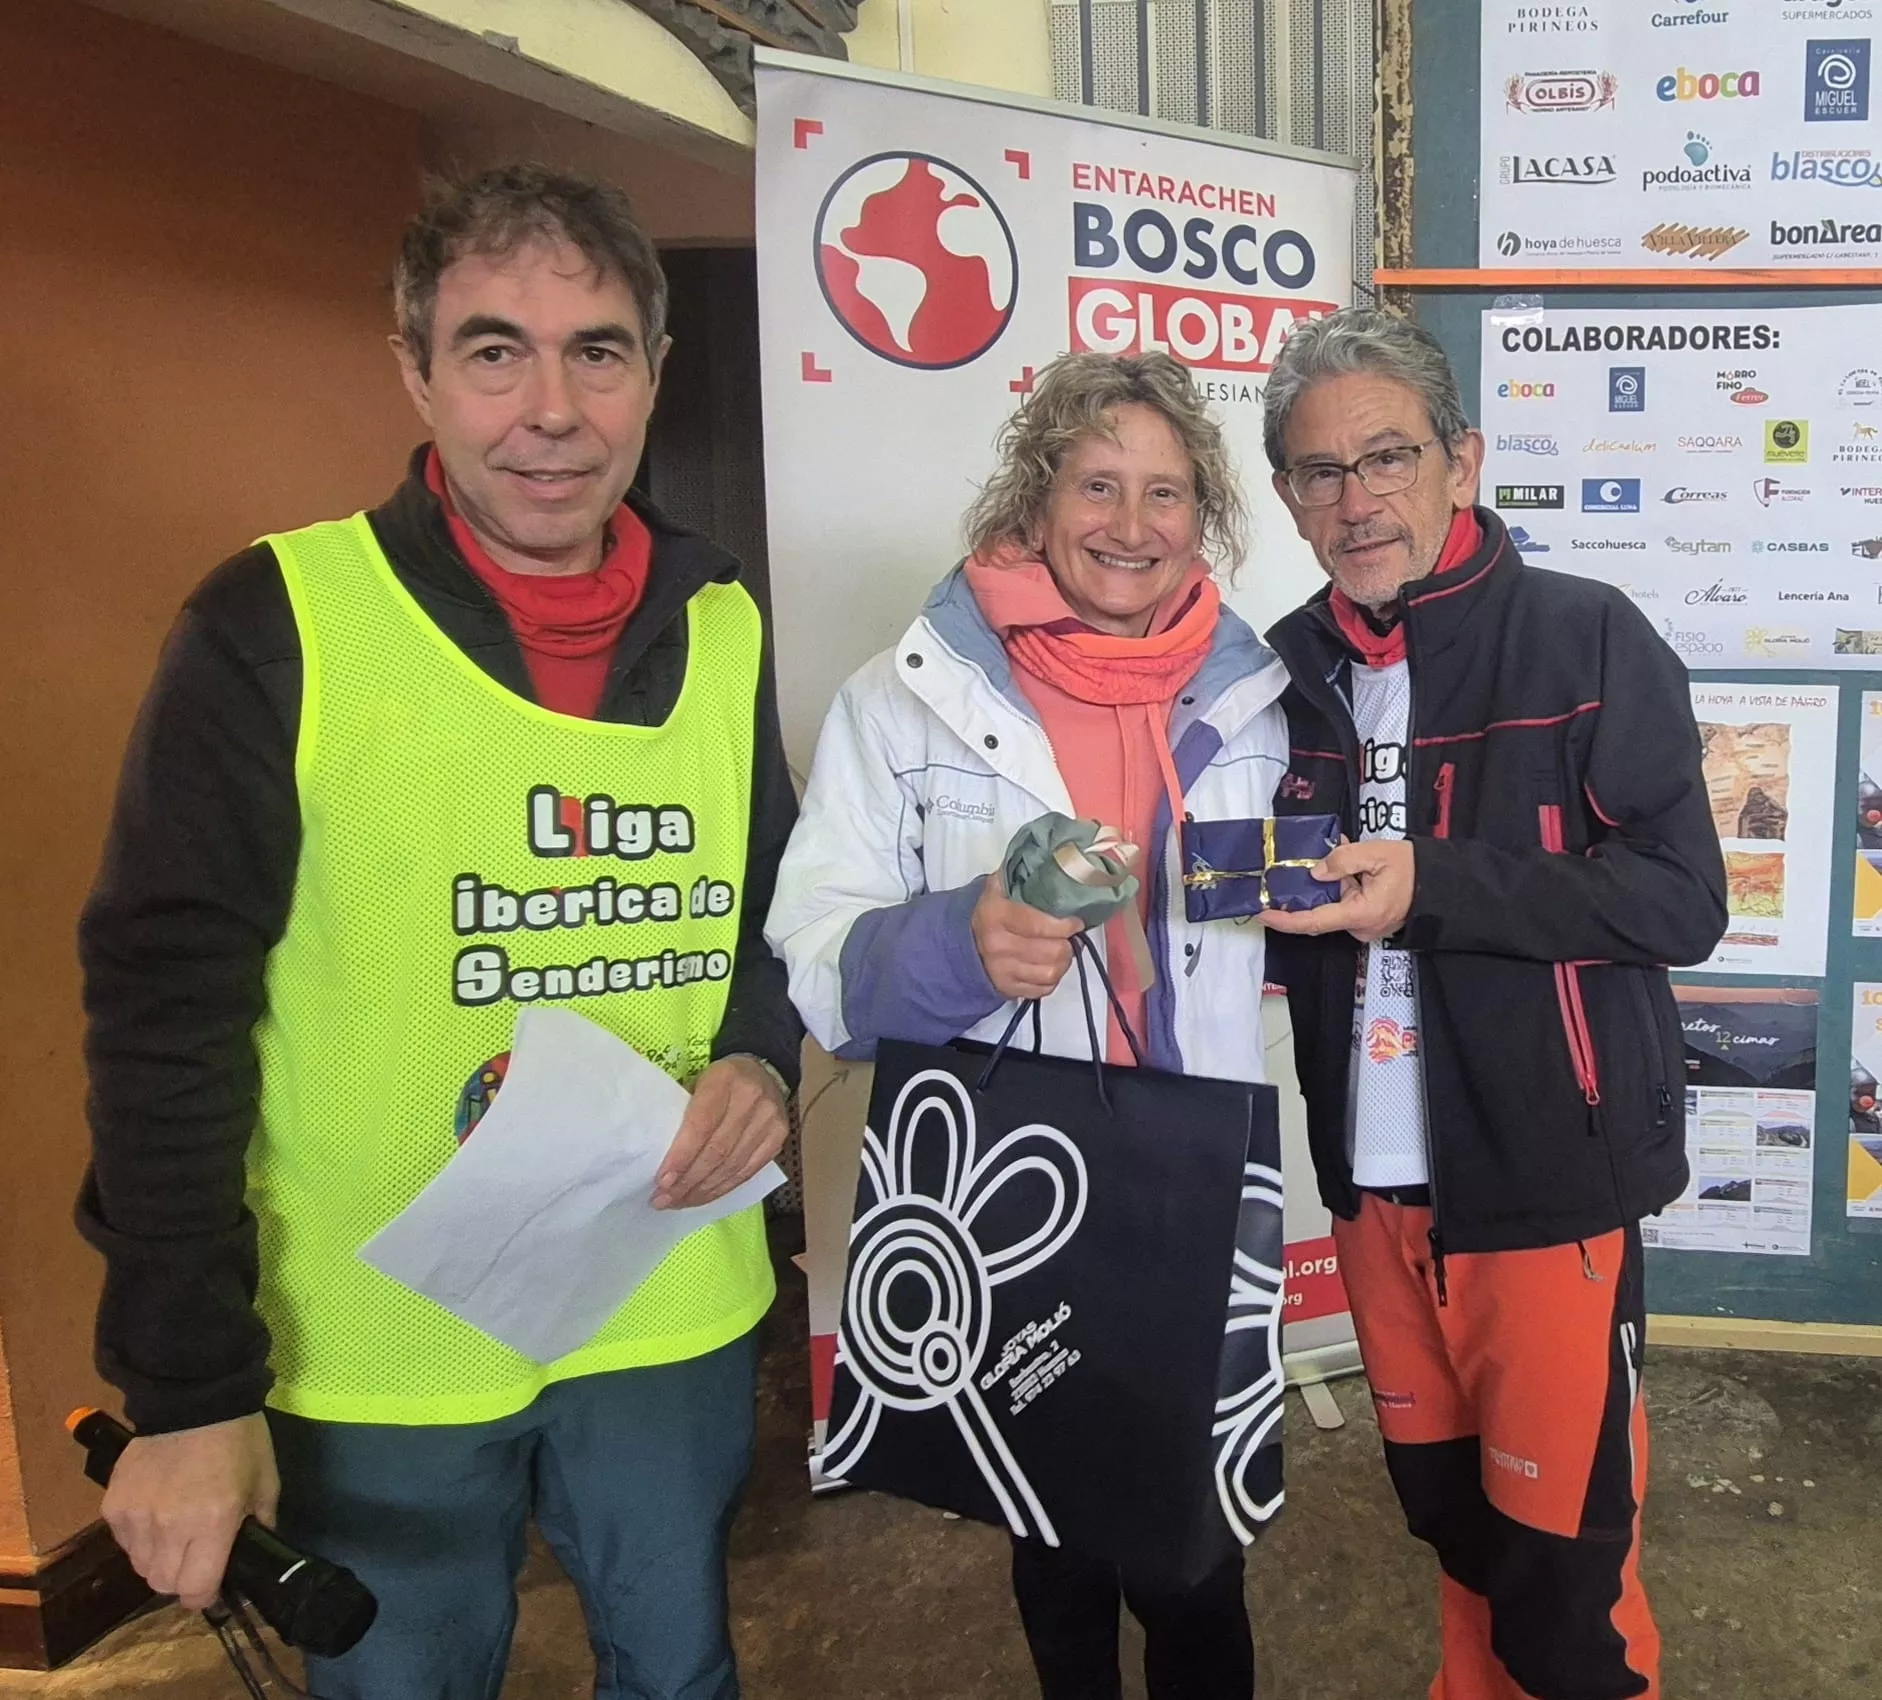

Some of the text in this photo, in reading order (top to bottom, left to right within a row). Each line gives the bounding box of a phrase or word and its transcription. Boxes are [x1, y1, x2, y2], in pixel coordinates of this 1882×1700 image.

[1517, 6, 1588, 18] BODEGA
[1651, 9, 1729, 28] Carrefour
[1782, 10, 1872, 20] SUPERMERCADOS
[1508, 20, 1599, 32] PIRINEOS
[1656, 67, 1760, 102] eboca
[1815, 90, 1857, 106] MIGUEL
[1815, 106, 1857, 114] ESCUER
[1513, 155, 1616, 184] LACASA
[1770, 151, 1872, 183] blasco
[1643, 164, 1752, 192] podoactiva
[1073, 162, 1276, 218] ENTARACHEN
[1073, 201, 1316, 290] BOSCO
[1525, 235, 1622, 251] hoya de huesca
[1076, 288, 1322, 364] GLOBA
[1502, 325, 1780, 352] COLABORADORES:
[1497, 378, 1555, 398] eboca
[1717, 381, 1742, 390] FINO
[1496, 434, 1551, 453] blasco
[1678, 436, 1743, 447] SAQQARA
[1513, 488, 1558, 500] MILAR
[1664, 487, 1729, 504] Correas
[1571, 539, 1647, 550] Saccohuesca
[1767, 542, 1829, 552] CASBAS
[1631, 589, 1659, 600] hotels
[1684, 578, 1747, 605] Álvaro
[1827, 591, 1850, 601] Ana
[1675, 632, 1706, 642] FISIO
[1675, 643, 1724, 656] espacio
[1708, 695, 1733, 704] HOYA
[1740, 696, 1746, 704] A
[1750, 696, 1773, 706] VISTA
[1775, 697, 1787, 707] DE
[528, 785, 695, 861] Liga
[453, 872, 735, 936] iberica de
[452, 944, 733, 1007] Senderismo
[1715, 1031, 1780, 1046] 12 cimas
[1001, 1321, 1038, 1357] JOYAS
[981, 1346, 1028, 1391] GLORIA
